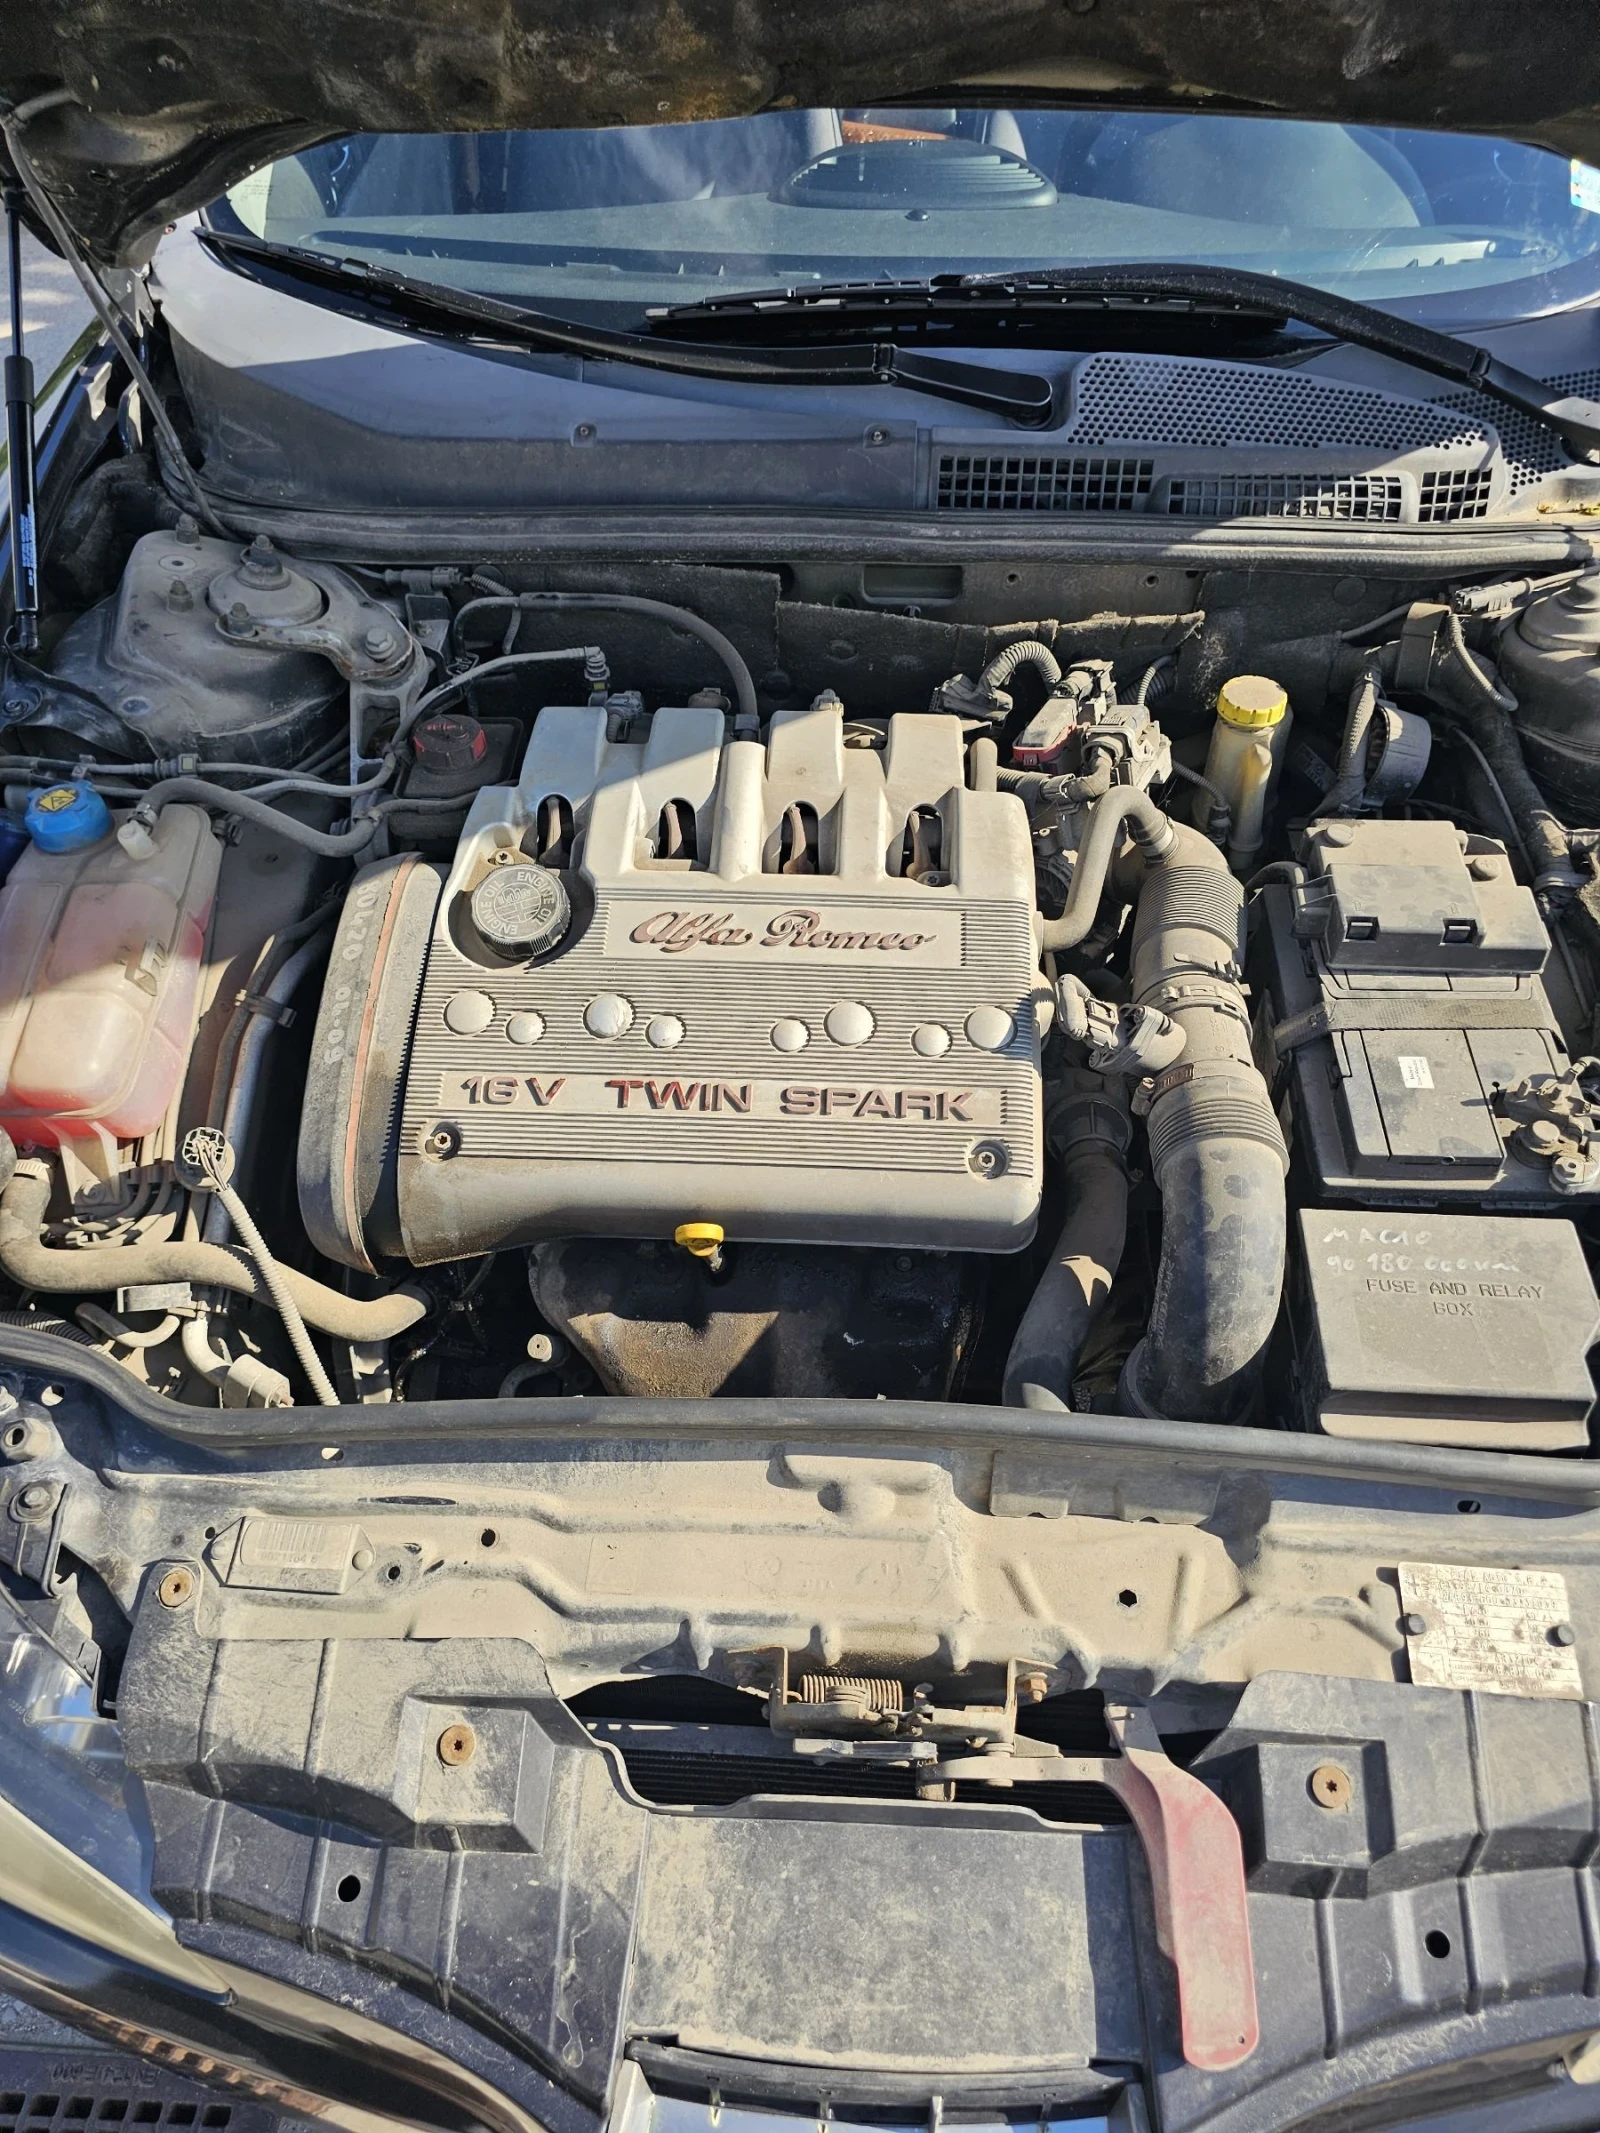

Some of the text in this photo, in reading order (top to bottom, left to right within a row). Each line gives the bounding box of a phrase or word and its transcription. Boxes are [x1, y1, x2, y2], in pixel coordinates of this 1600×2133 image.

[481, 879, 518, 935] ENGINE OIL
[517, 871, 554, 925] ENGINE OIL
[629, 909, 938, 953] Alfa Romeo
[606, 1080, 753, 1113] TWIN
[779, 1084, 975, 1122] SPARK
[1366, 1279, 1544, 1299] FUSE AND RELAY
[1433, 1301, 1475, 1316] BOX
